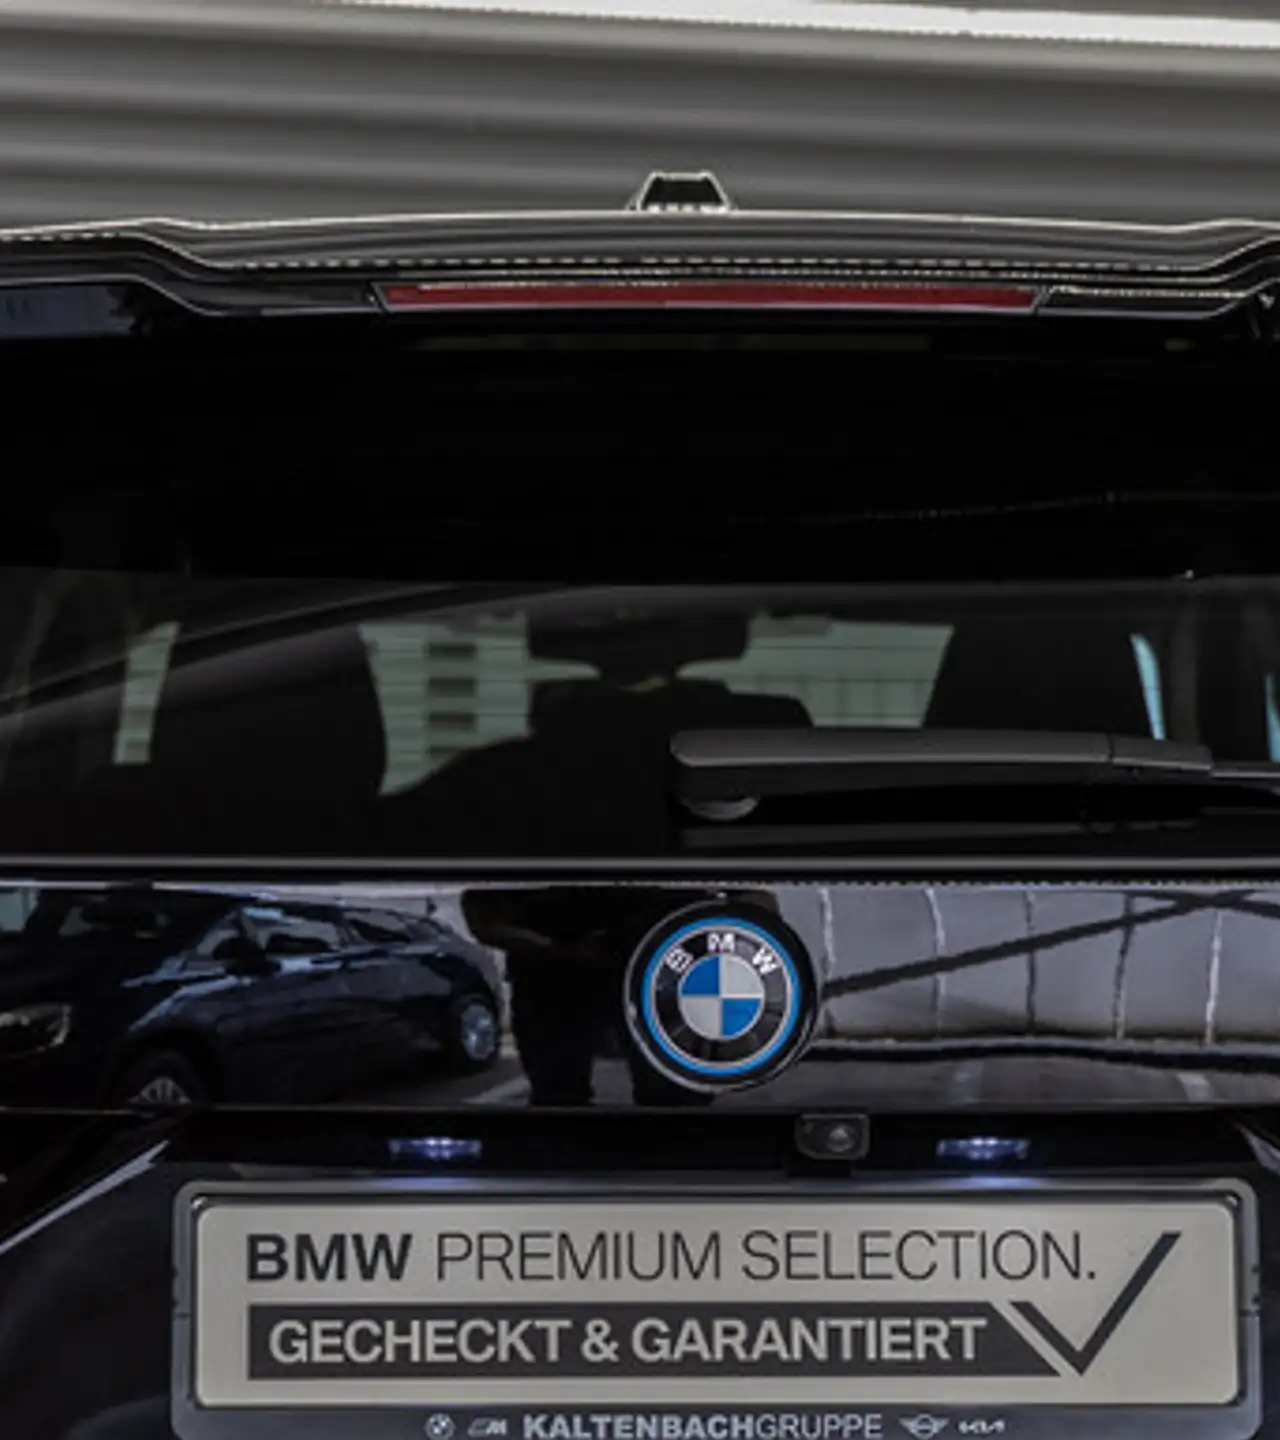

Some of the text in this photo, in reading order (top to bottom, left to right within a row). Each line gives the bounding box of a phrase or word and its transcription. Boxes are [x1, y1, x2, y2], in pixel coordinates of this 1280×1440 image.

[664, 932, 782, 975] BMW
[246, 1229, 1097, 1282] BMW PREMIUM SELECTION.
[268, 1317, 987, 1364] GECHECKT & GARANTIERT
